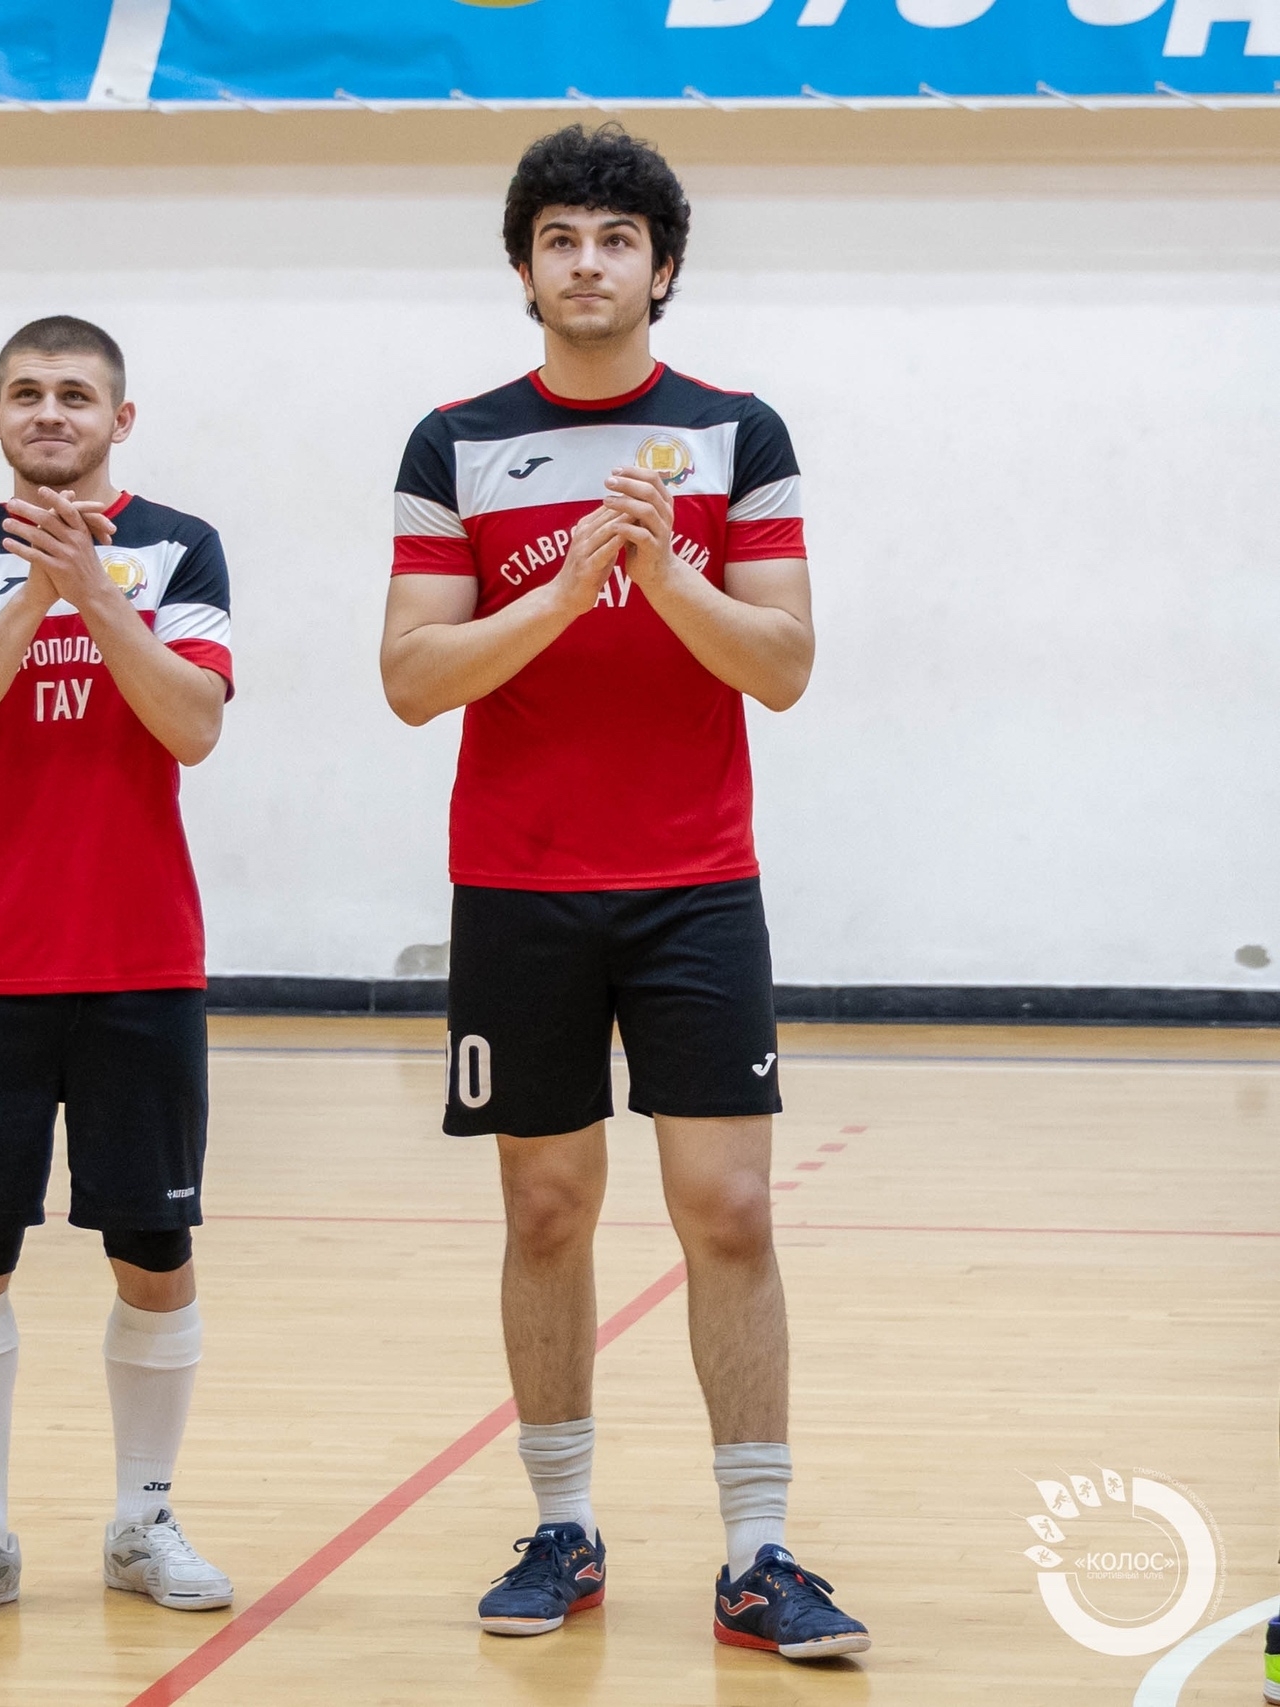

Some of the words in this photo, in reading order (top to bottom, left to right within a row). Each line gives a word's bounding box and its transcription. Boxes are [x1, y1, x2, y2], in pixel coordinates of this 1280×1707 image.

[593, 566, 632, 607] АУ
[17, 636, 103, 671] РОПОЛЬ
[36, 678, 93, 722] ГАУ
[446, 1030, 492, 1108] 0
